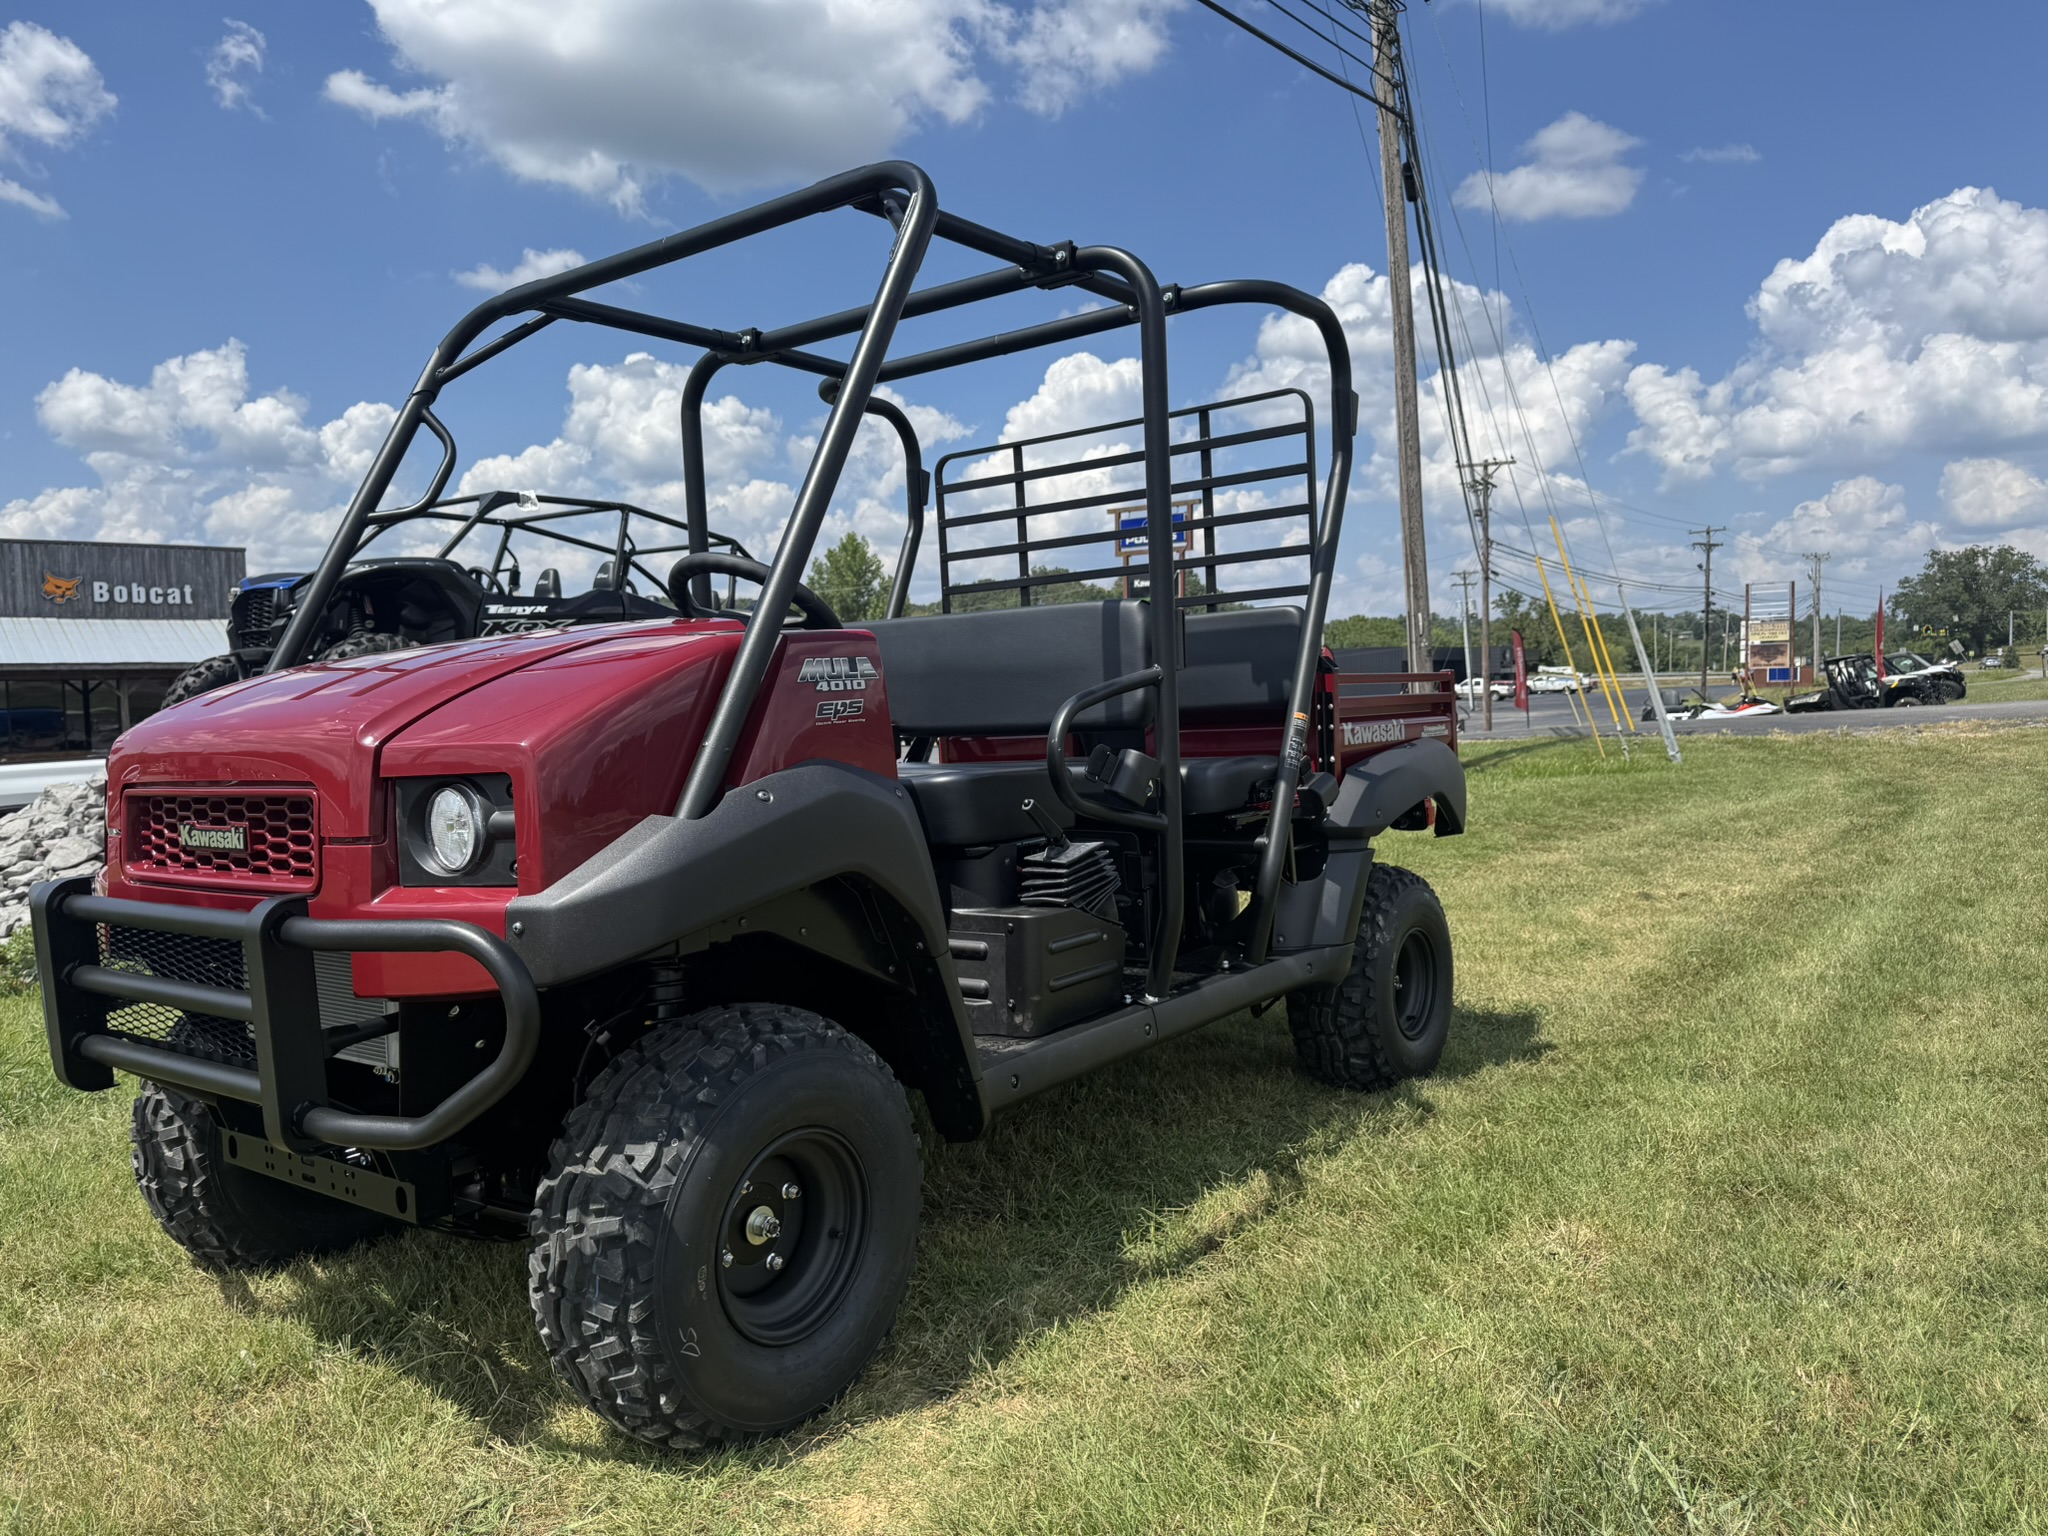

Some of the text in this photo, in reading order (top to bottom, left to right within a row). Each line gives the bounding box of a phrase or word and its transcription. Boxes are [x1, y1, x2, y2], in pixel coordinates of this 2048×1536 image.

[92, 580, 194, 605] Bobcat
[797, 656, 880, 683] MULE
[816, 679, 866, 691] 4010
[1341, 718, 1406, 746] Kawasaki
[179, 824, 245, 850] Kawasaki
